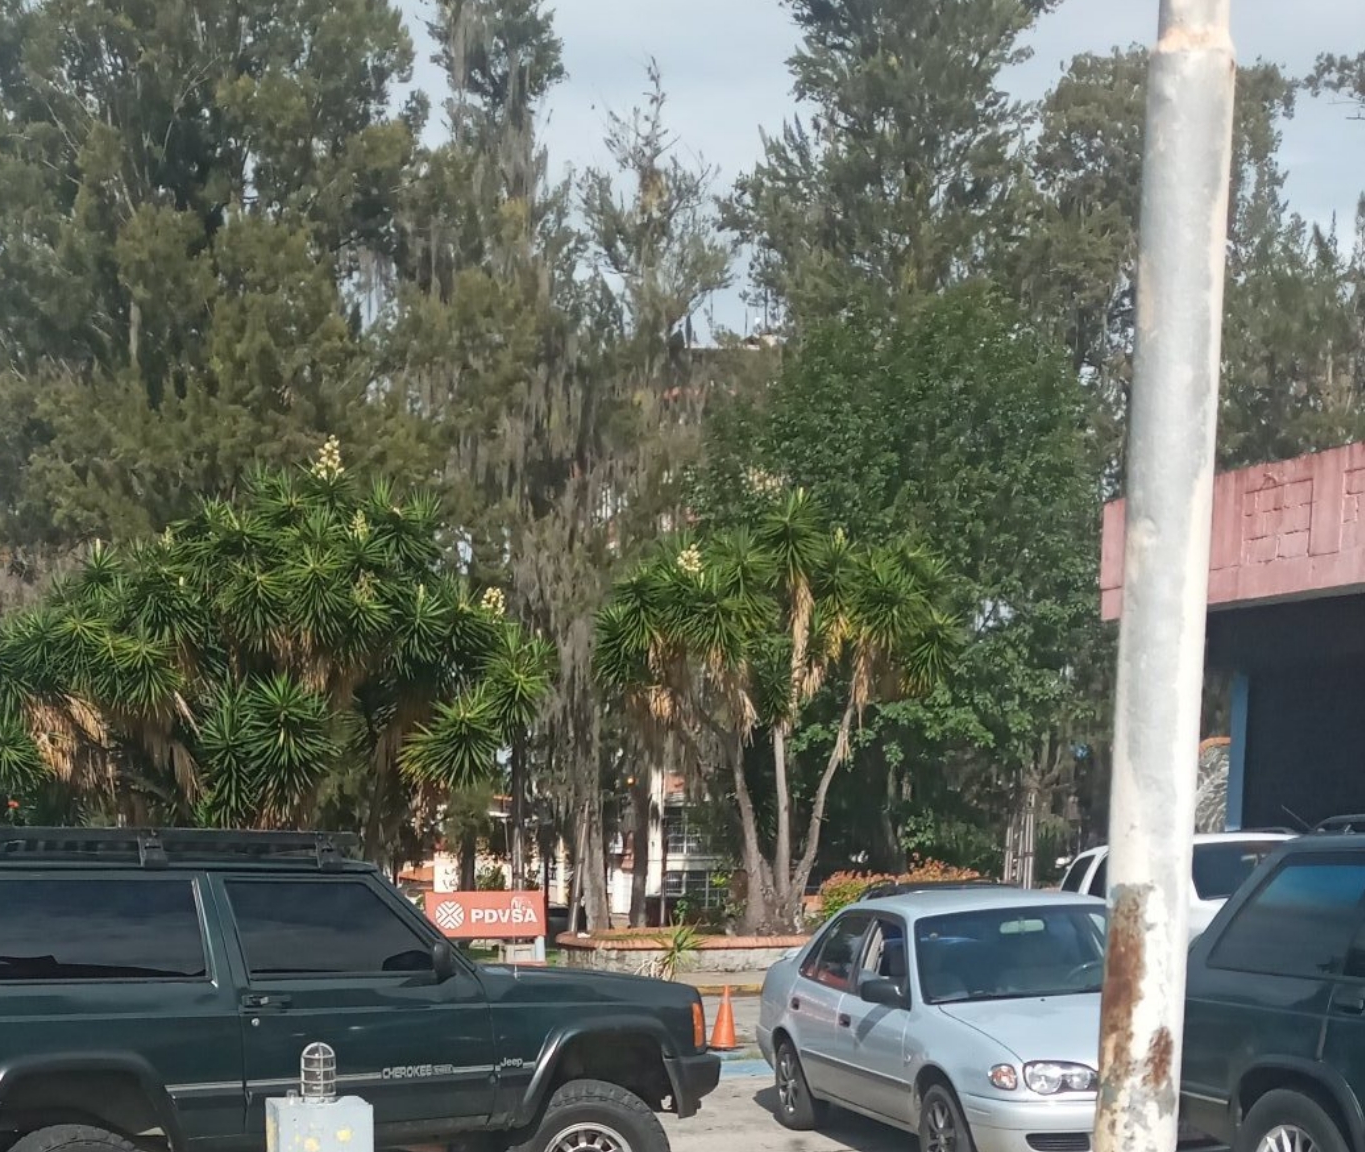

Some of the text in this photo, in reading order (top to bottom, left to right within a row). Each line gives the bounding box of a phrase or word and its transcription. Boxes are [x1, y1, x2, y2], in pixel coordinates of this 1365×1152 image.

[471, 908, 538, 923] PDVSA
[500, 1057, 523, 1068] Jeep
[382, 1064, 433, 1080] CHEROKEE
